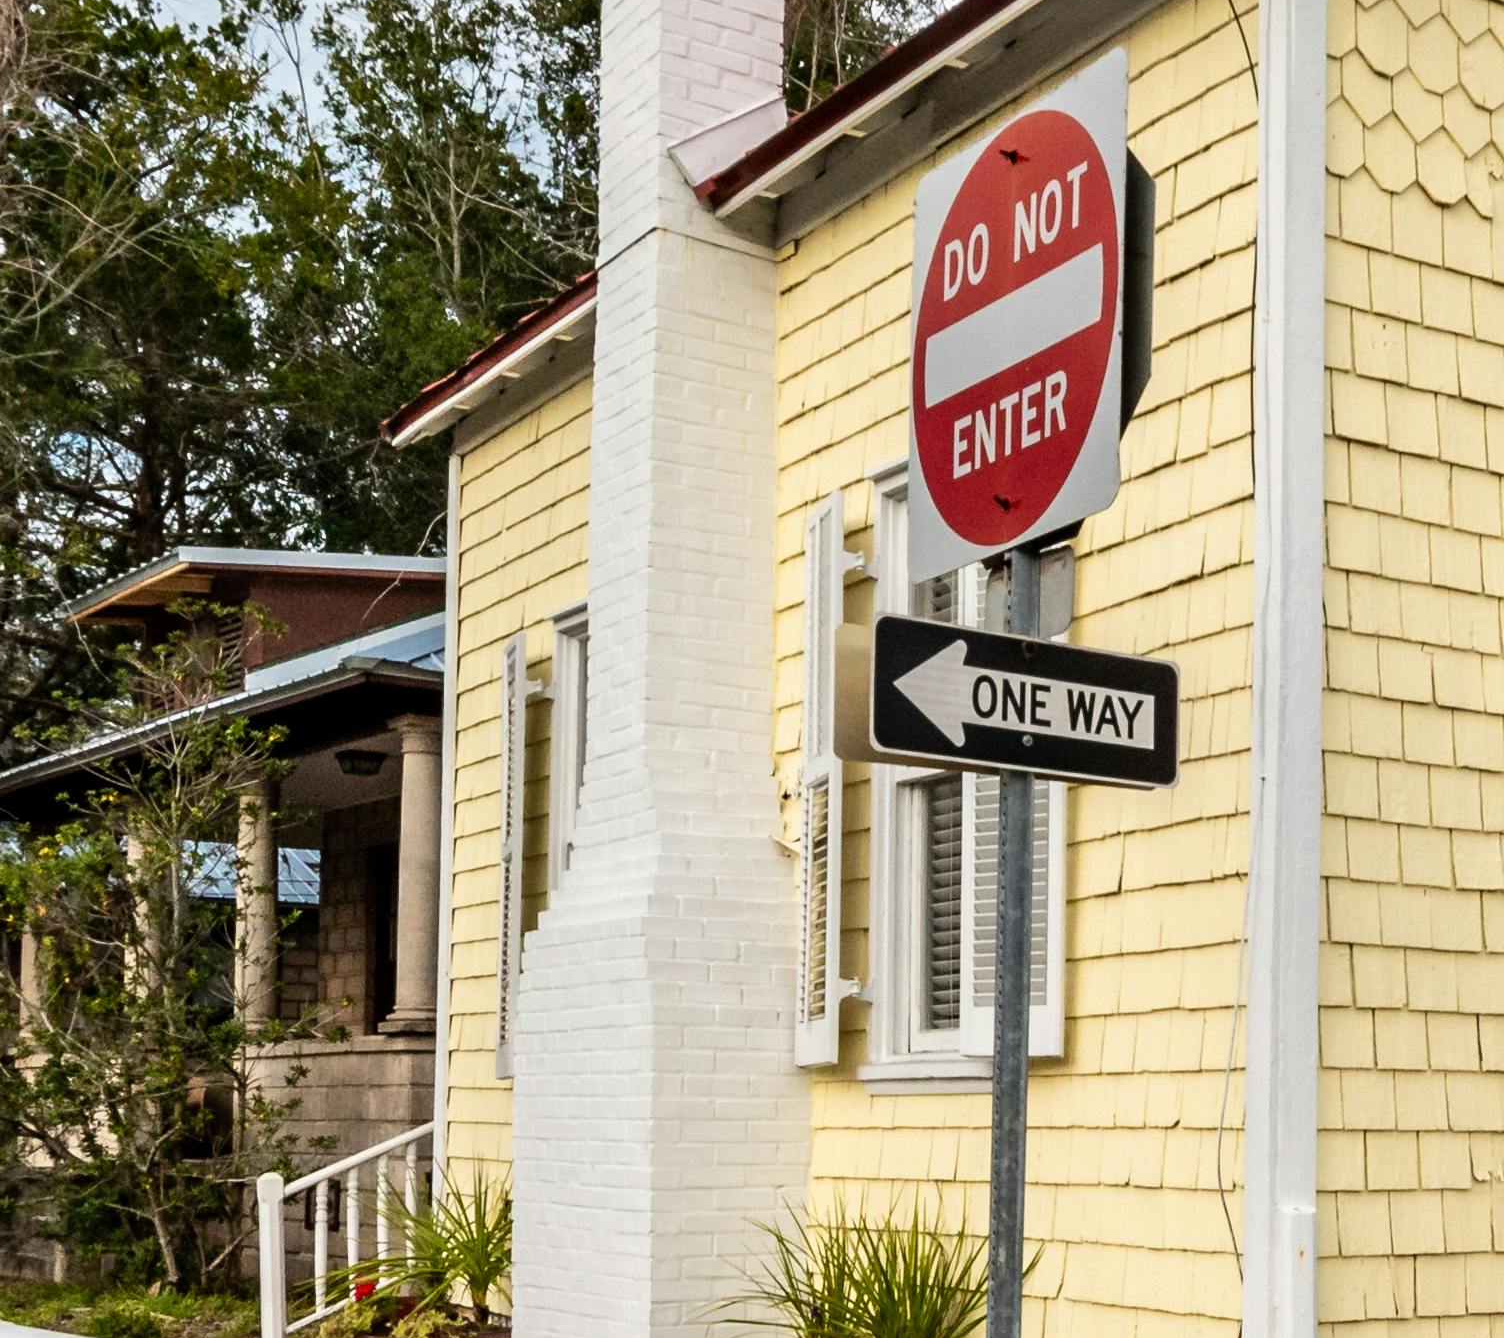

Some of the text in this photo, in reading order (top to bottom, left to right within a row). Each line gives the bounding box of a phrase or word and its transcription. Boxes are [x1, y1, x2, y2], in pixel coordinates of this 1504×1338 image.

[944, 161, 1088, 302] DO NOT
[953, 370, 1067, 479] ENTER
[972, 674, 1144, 740] ONE WAY
